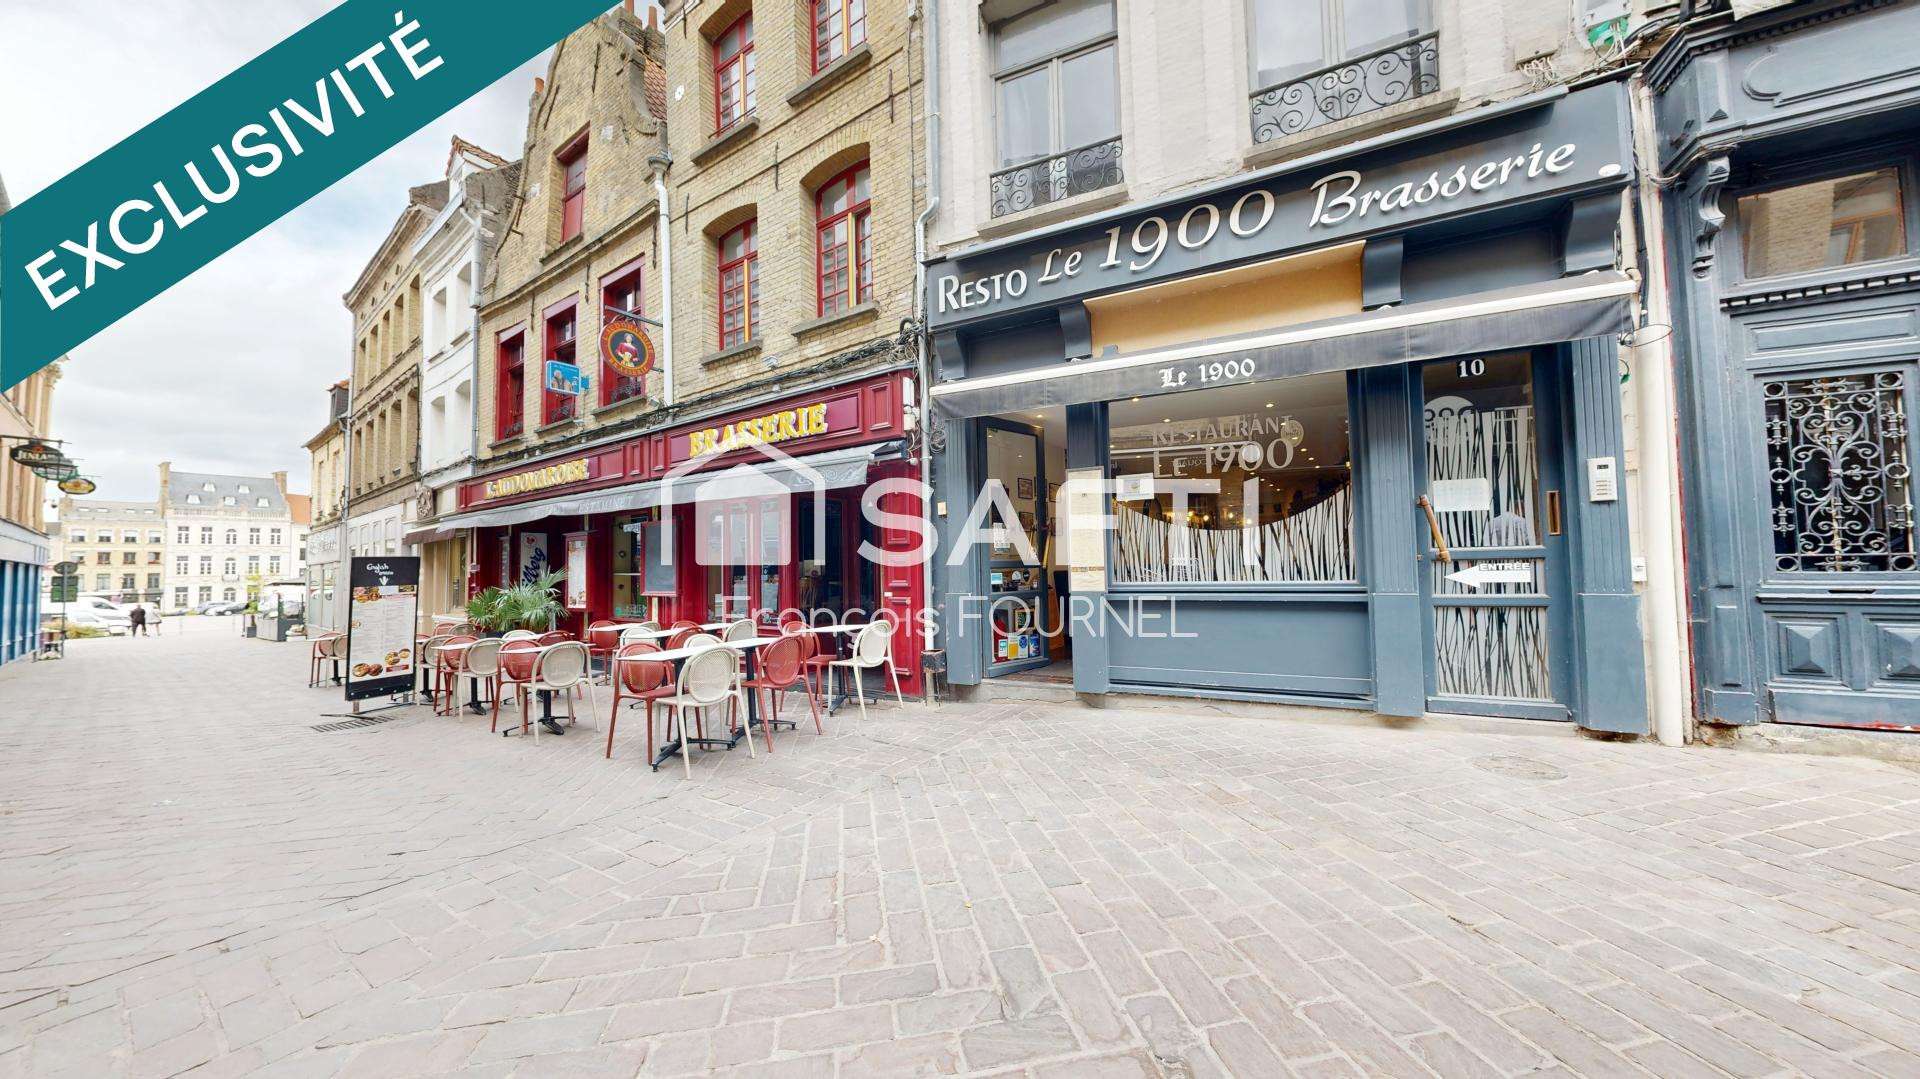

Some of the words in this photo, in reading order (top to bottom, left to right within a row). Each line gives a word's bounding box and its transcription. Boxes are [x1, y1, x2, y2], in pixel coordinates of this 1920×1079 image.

[938, 269, 1027, 313] RESTO
[1037, 249, 1082, 284] Le
[1099, 189, 1276, 273] 1900
[1309, 143, 1577, 228] Brasserie
[1159, 367, 1187, 388] Le
[1199, 358, 1256, 382] 1900
[1459, 359, 1485, 378] 10
[689, 403, 828, 458] BRASSERIE
[1152, 415, 1293, 446] RESTAURANT
[1153, 451, 1188, 478] LE
[1204, 439, 1294, 474] 1900
[1479, 561, 1531, 571] ENTRÉE
